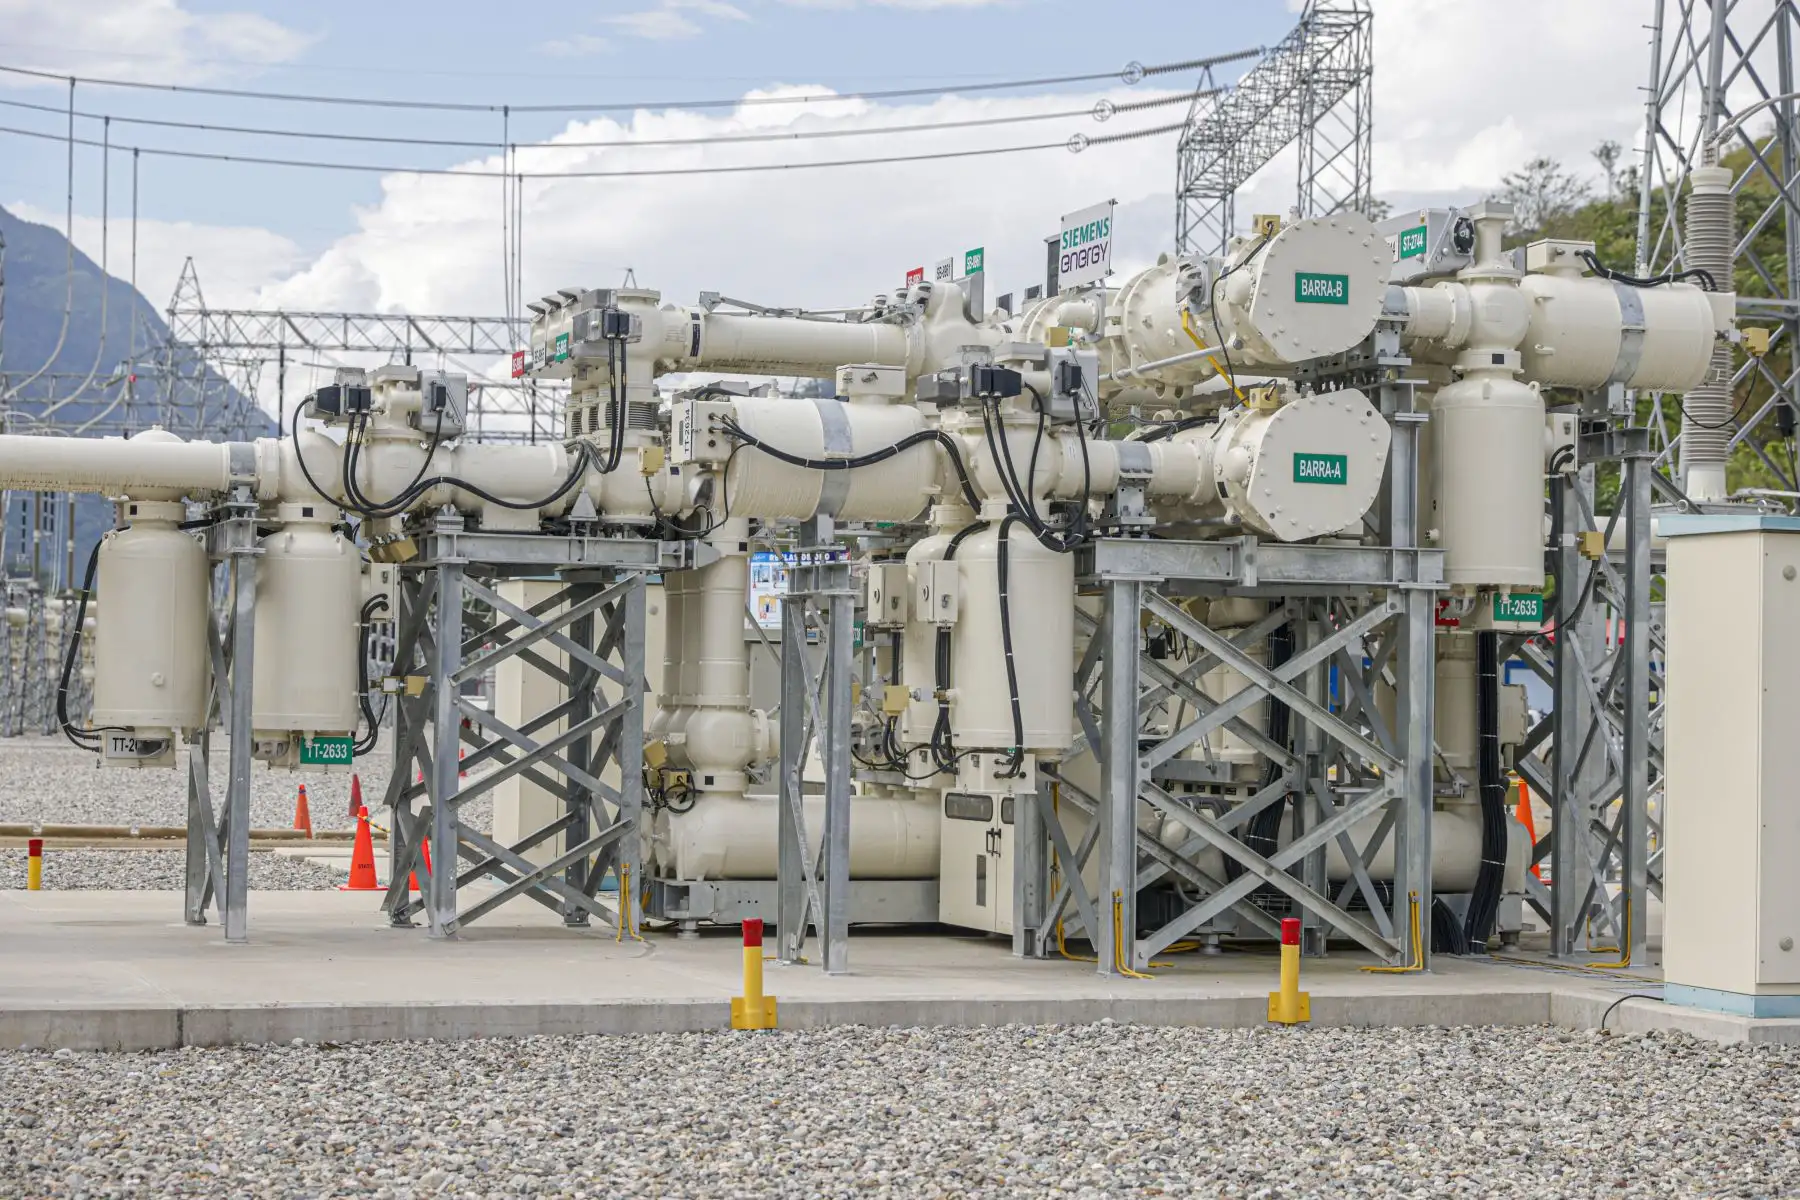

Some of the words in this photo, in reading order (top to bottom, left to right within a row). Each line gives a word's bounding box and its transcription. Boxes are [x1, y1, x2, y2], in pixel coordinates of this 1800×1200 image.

[1062, 217, 1109, 249] SIEMENS
[1301, 279, 1343, 297] BARRA-B
[1300, 459, 1341, 479] BARRA-A
[1500, 599, 1537, 616] TT-2635
[112, 737, 138, 753] TT-2
[306, 743, 348, 759] TT-2633
